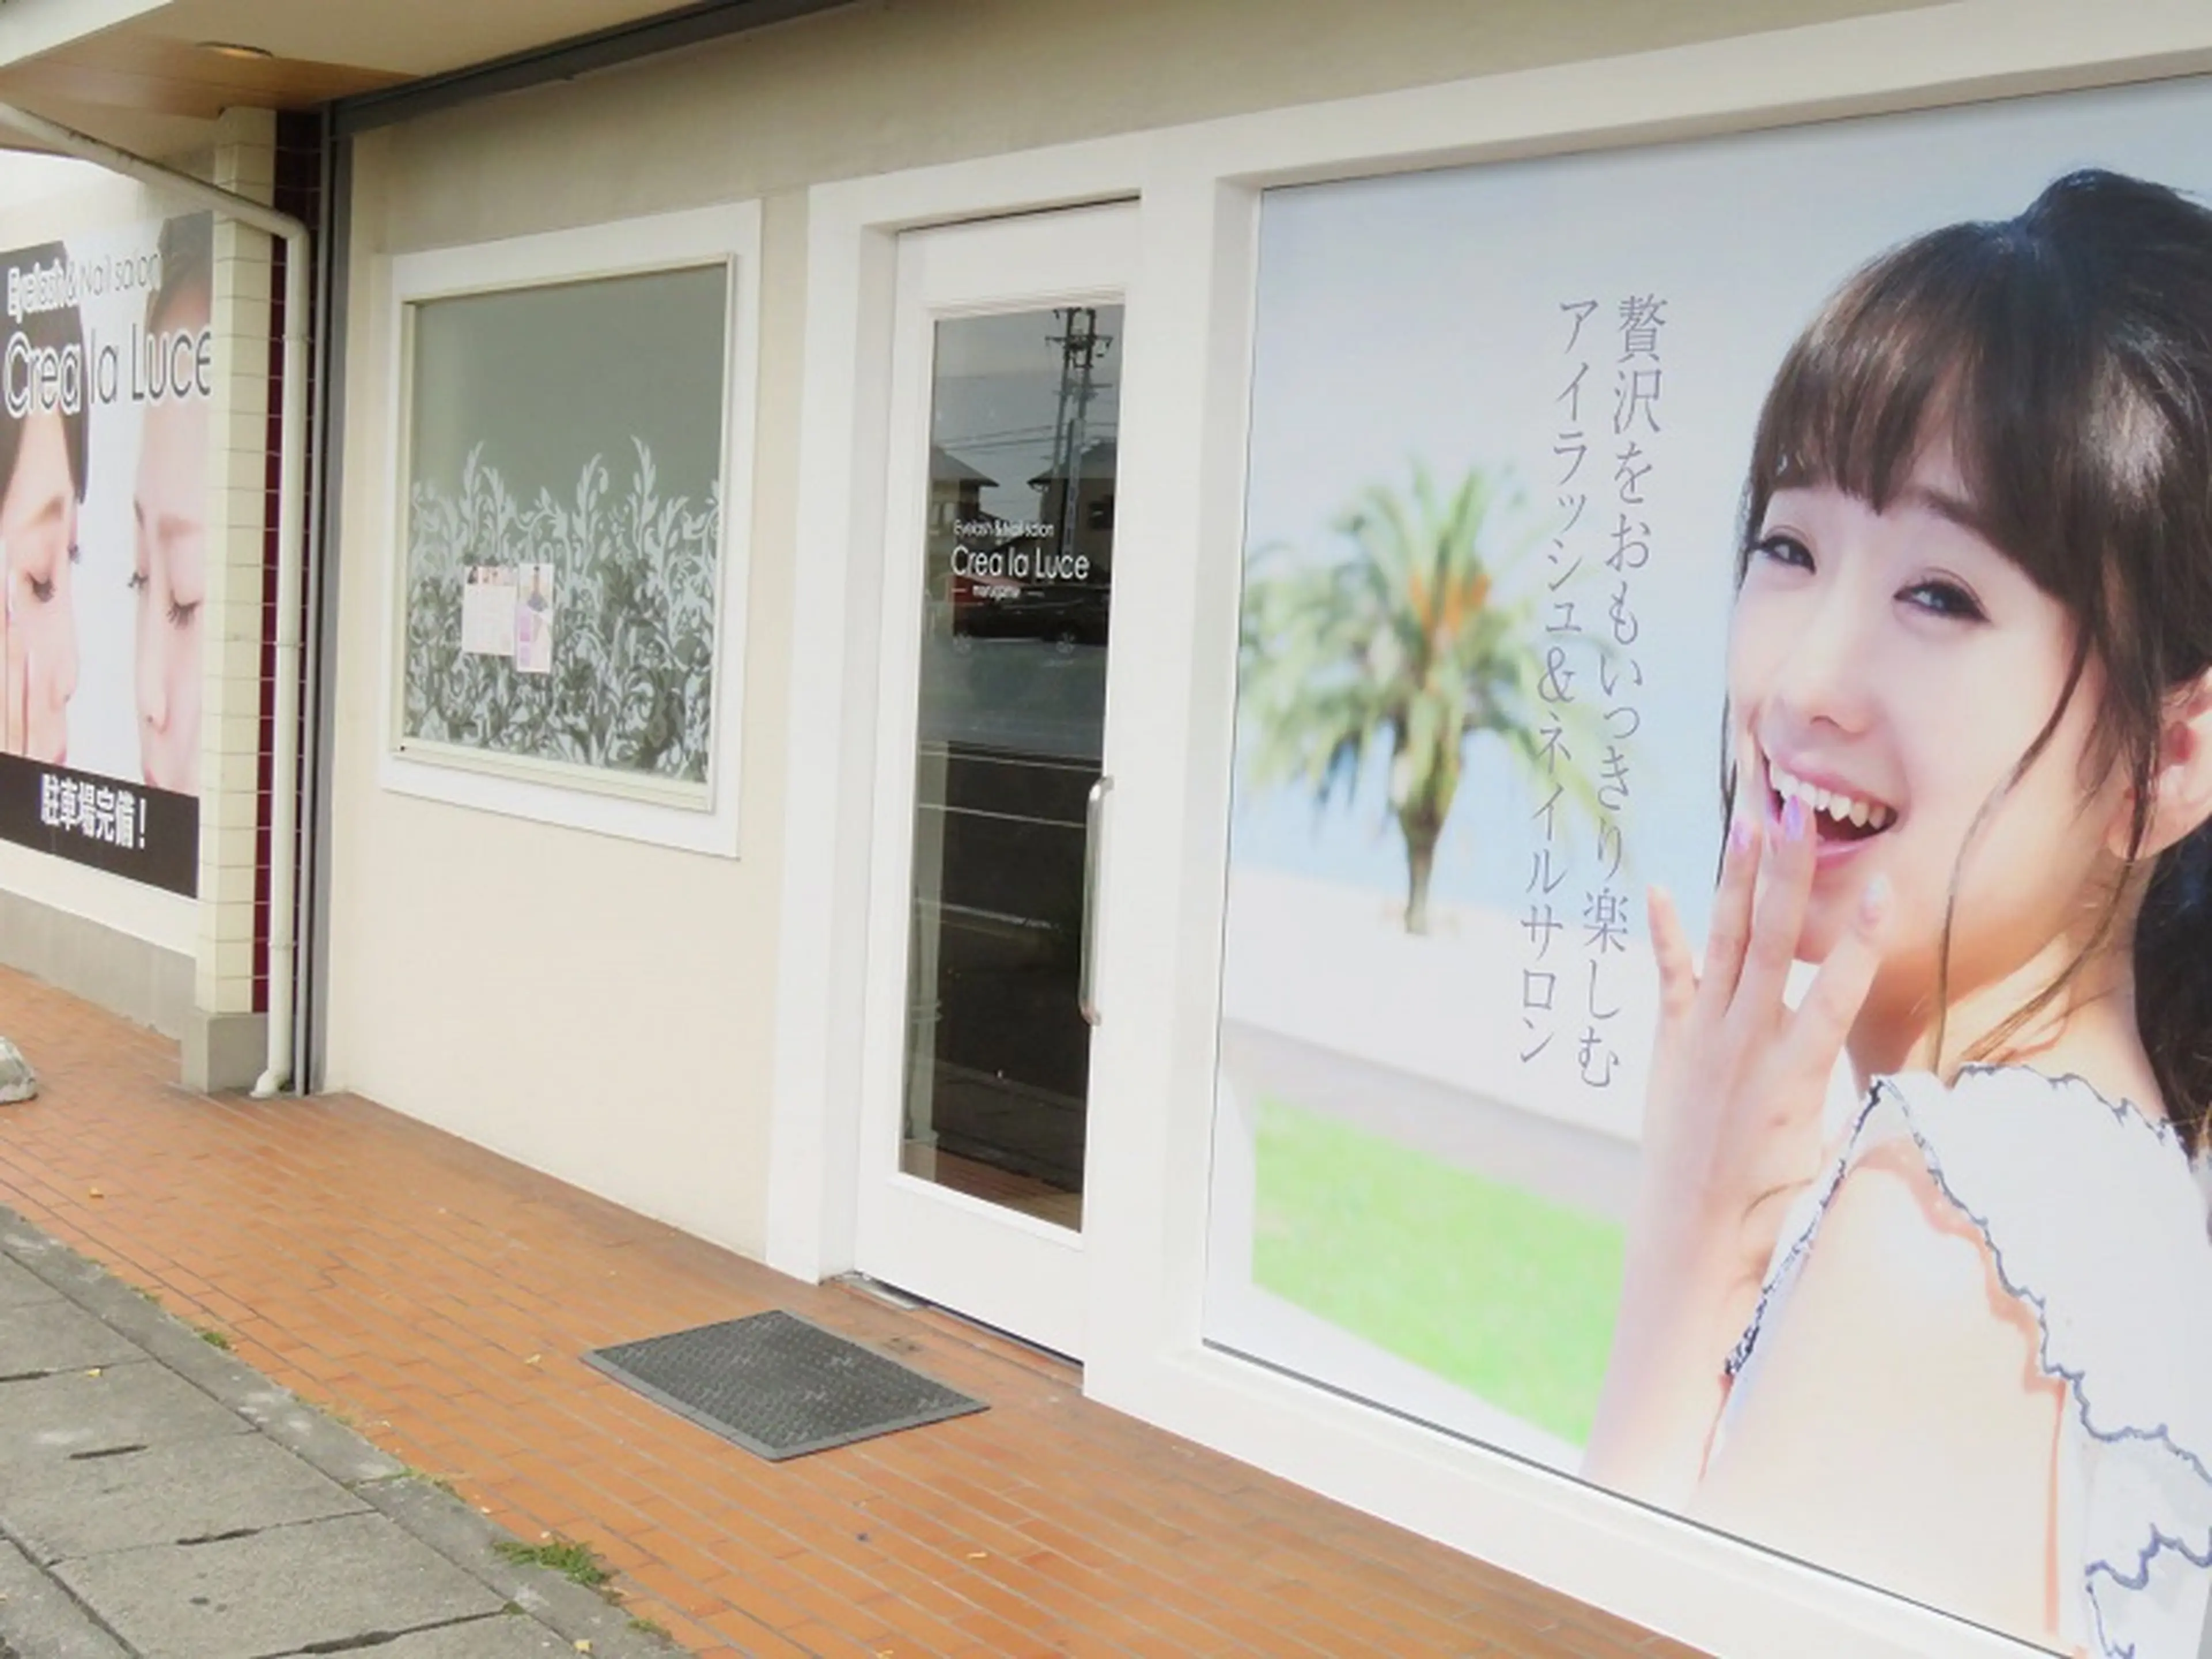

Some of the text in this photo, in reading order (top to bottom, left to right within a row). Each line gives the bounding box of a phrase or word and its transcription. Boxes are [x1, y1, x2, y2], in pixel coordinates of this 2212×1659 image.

[4, 332, 81, 418] Crea
[90, 327, 119, 405] la
[950, 544, 1090, 580] Crea la Luce
[1520, 299, 1599, 1063] アイラッシュ&ネイルサロン
[1577, 293, 1668, 1089] 贅沢をおもいっきり楽しむ
